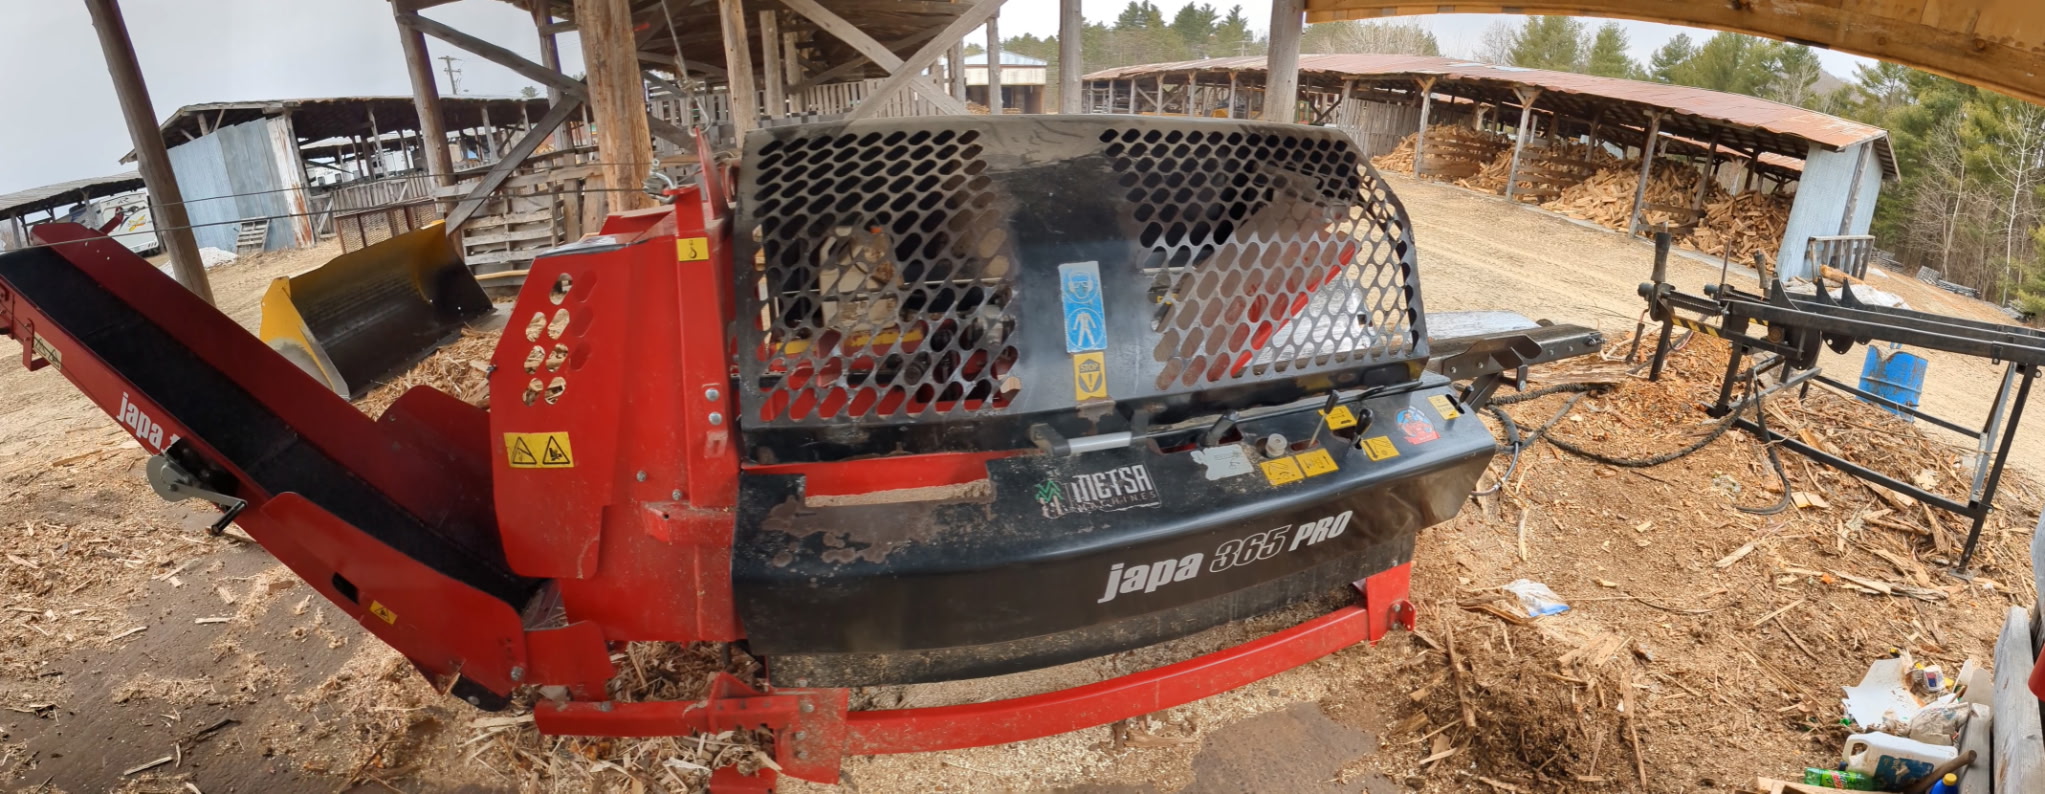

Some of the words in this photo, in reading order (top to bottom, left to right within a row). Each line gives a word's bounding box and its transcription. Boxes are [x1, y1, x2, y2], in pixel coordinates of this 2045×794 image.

[1071, 464, 1153, 503] METSA
[1097, 552, 1205, 604] japa
[1208, 524, 1292, 573] 365
[1288, 510, 1354, 552] PRO
